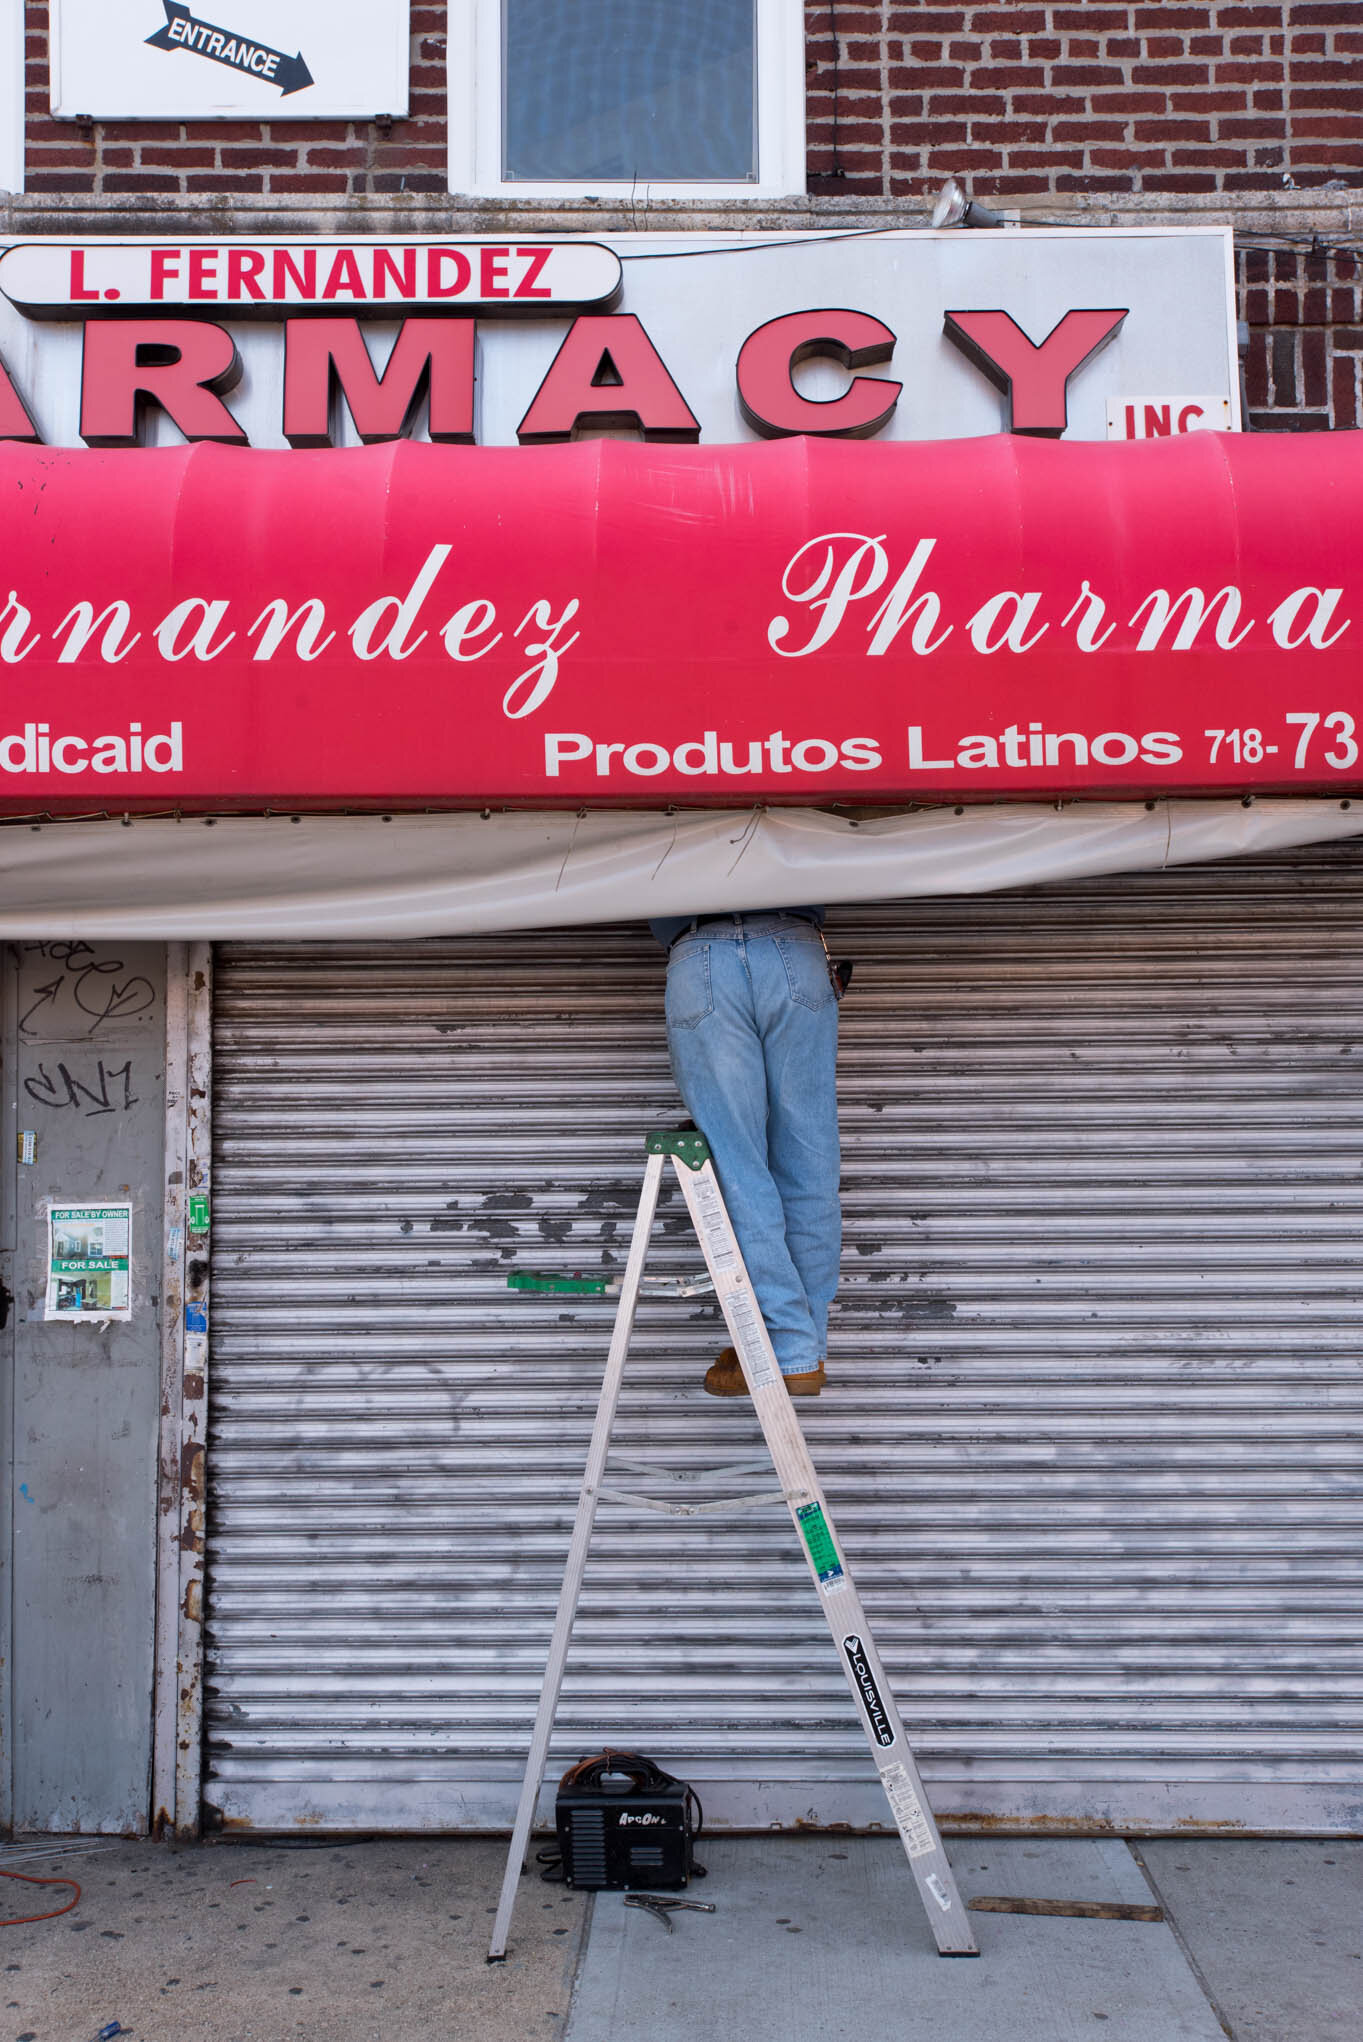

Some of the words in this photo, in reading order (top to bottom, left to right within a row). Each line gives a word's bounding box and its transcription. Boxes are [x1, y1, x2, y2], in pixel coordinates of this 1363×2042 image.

[167, 16, 283, 79] ENTRANCE
[69, 249, 121, 301] L.
[149, 247, 553, 301] FERNANDEZ
[0, 309, 1130, 446] RMACY
[767, 532, 1352, 658] Pharma
[0, 721, 184, 775] dicaid
[542, 730, 883, 778] Produtos
[907, 723, 1183, 771] Latinos
[61, 1261, 87, 1270] FOR
[88, 1261, 119, 1269] SALE
[853, 1654, 891, 1746] LOUISVILLE
